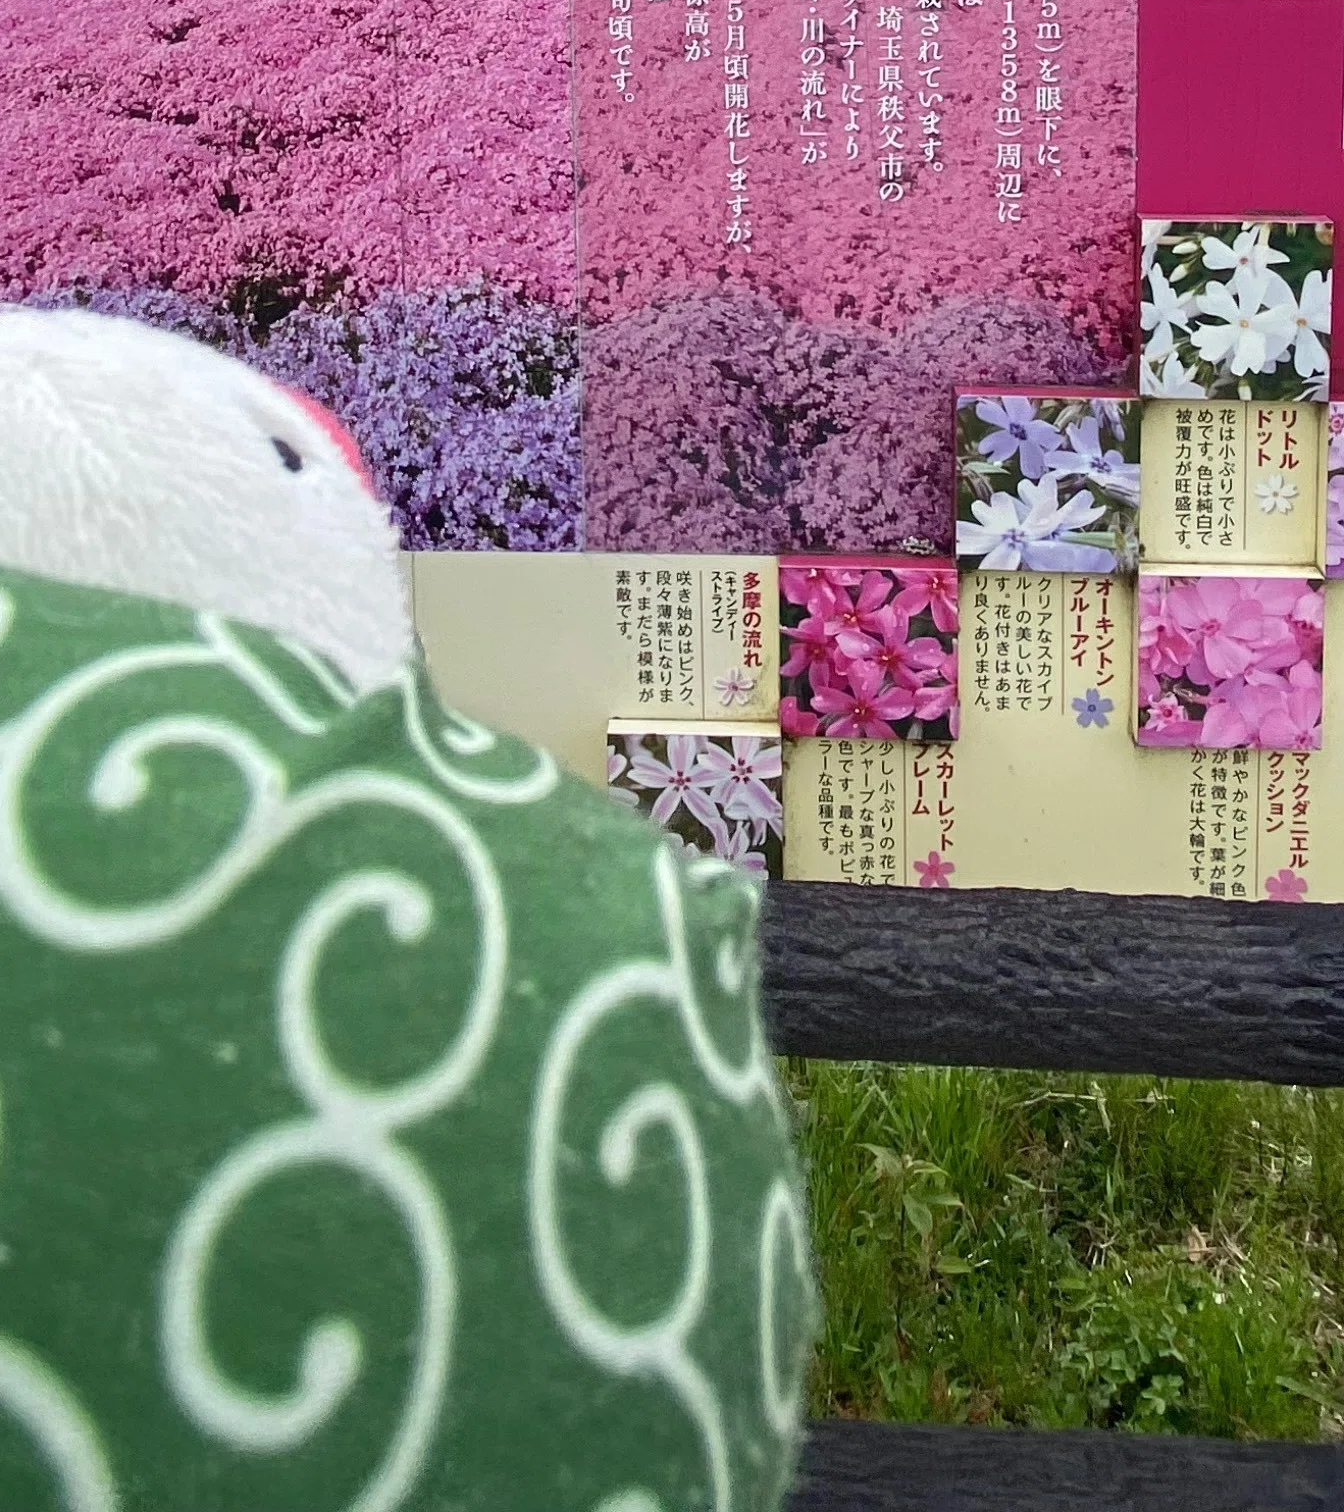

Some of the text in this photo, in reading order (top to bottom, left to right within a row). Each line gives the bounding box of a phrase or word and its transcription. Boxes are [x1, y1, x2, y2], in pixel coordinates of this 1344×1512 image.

[1174, 407, 1193, 550] 被覆力が旺盛です。
[1196, 409, 1214, 546] めです。色は純白で
[1217, 408, 1236, 547] 花は小ぶりで小さ
[1257, 409, 1274, 467] ドット
[1279, 409, 1300, 470] リトル
[616, 569, 633, 641] 素敵です。
[635, 570, 654, 704] す。まだら模様が
[656, 570, 674, 703] 段々薄紫になりま
[676, 570, 695, 707] 咲き始めはピンク、
[742, 571, 763, 668] 多摩の流れ
[974, 576, 991, 713] り良くありません。
[994, 576, 1012, 711] す。花付きはあま
[1015, 577, 1033, 712] ルーの美しい花で
[1037, 576, 1054, 712] クリアなスカイブ
[1070, 577, 1090, 668] ブルーアイ
[1095, 578, 1115, 687] オーキントン
[818, 739, 834, 856] ラーな品種です。
[912, 741, 930, 816] フレーム
[936, 742, 955, 852] スカーレット
[1189, 749, 1207, 886] かく花は大輪です。
[1208, 749, 1228, 897] が特徴です。葉が細
[1231, 749, 1249, 897] 鮮やかなピンク色
[1265, 751, 1284, 833] クッション
[1289, 752, 1311, 869] マックダニエル
